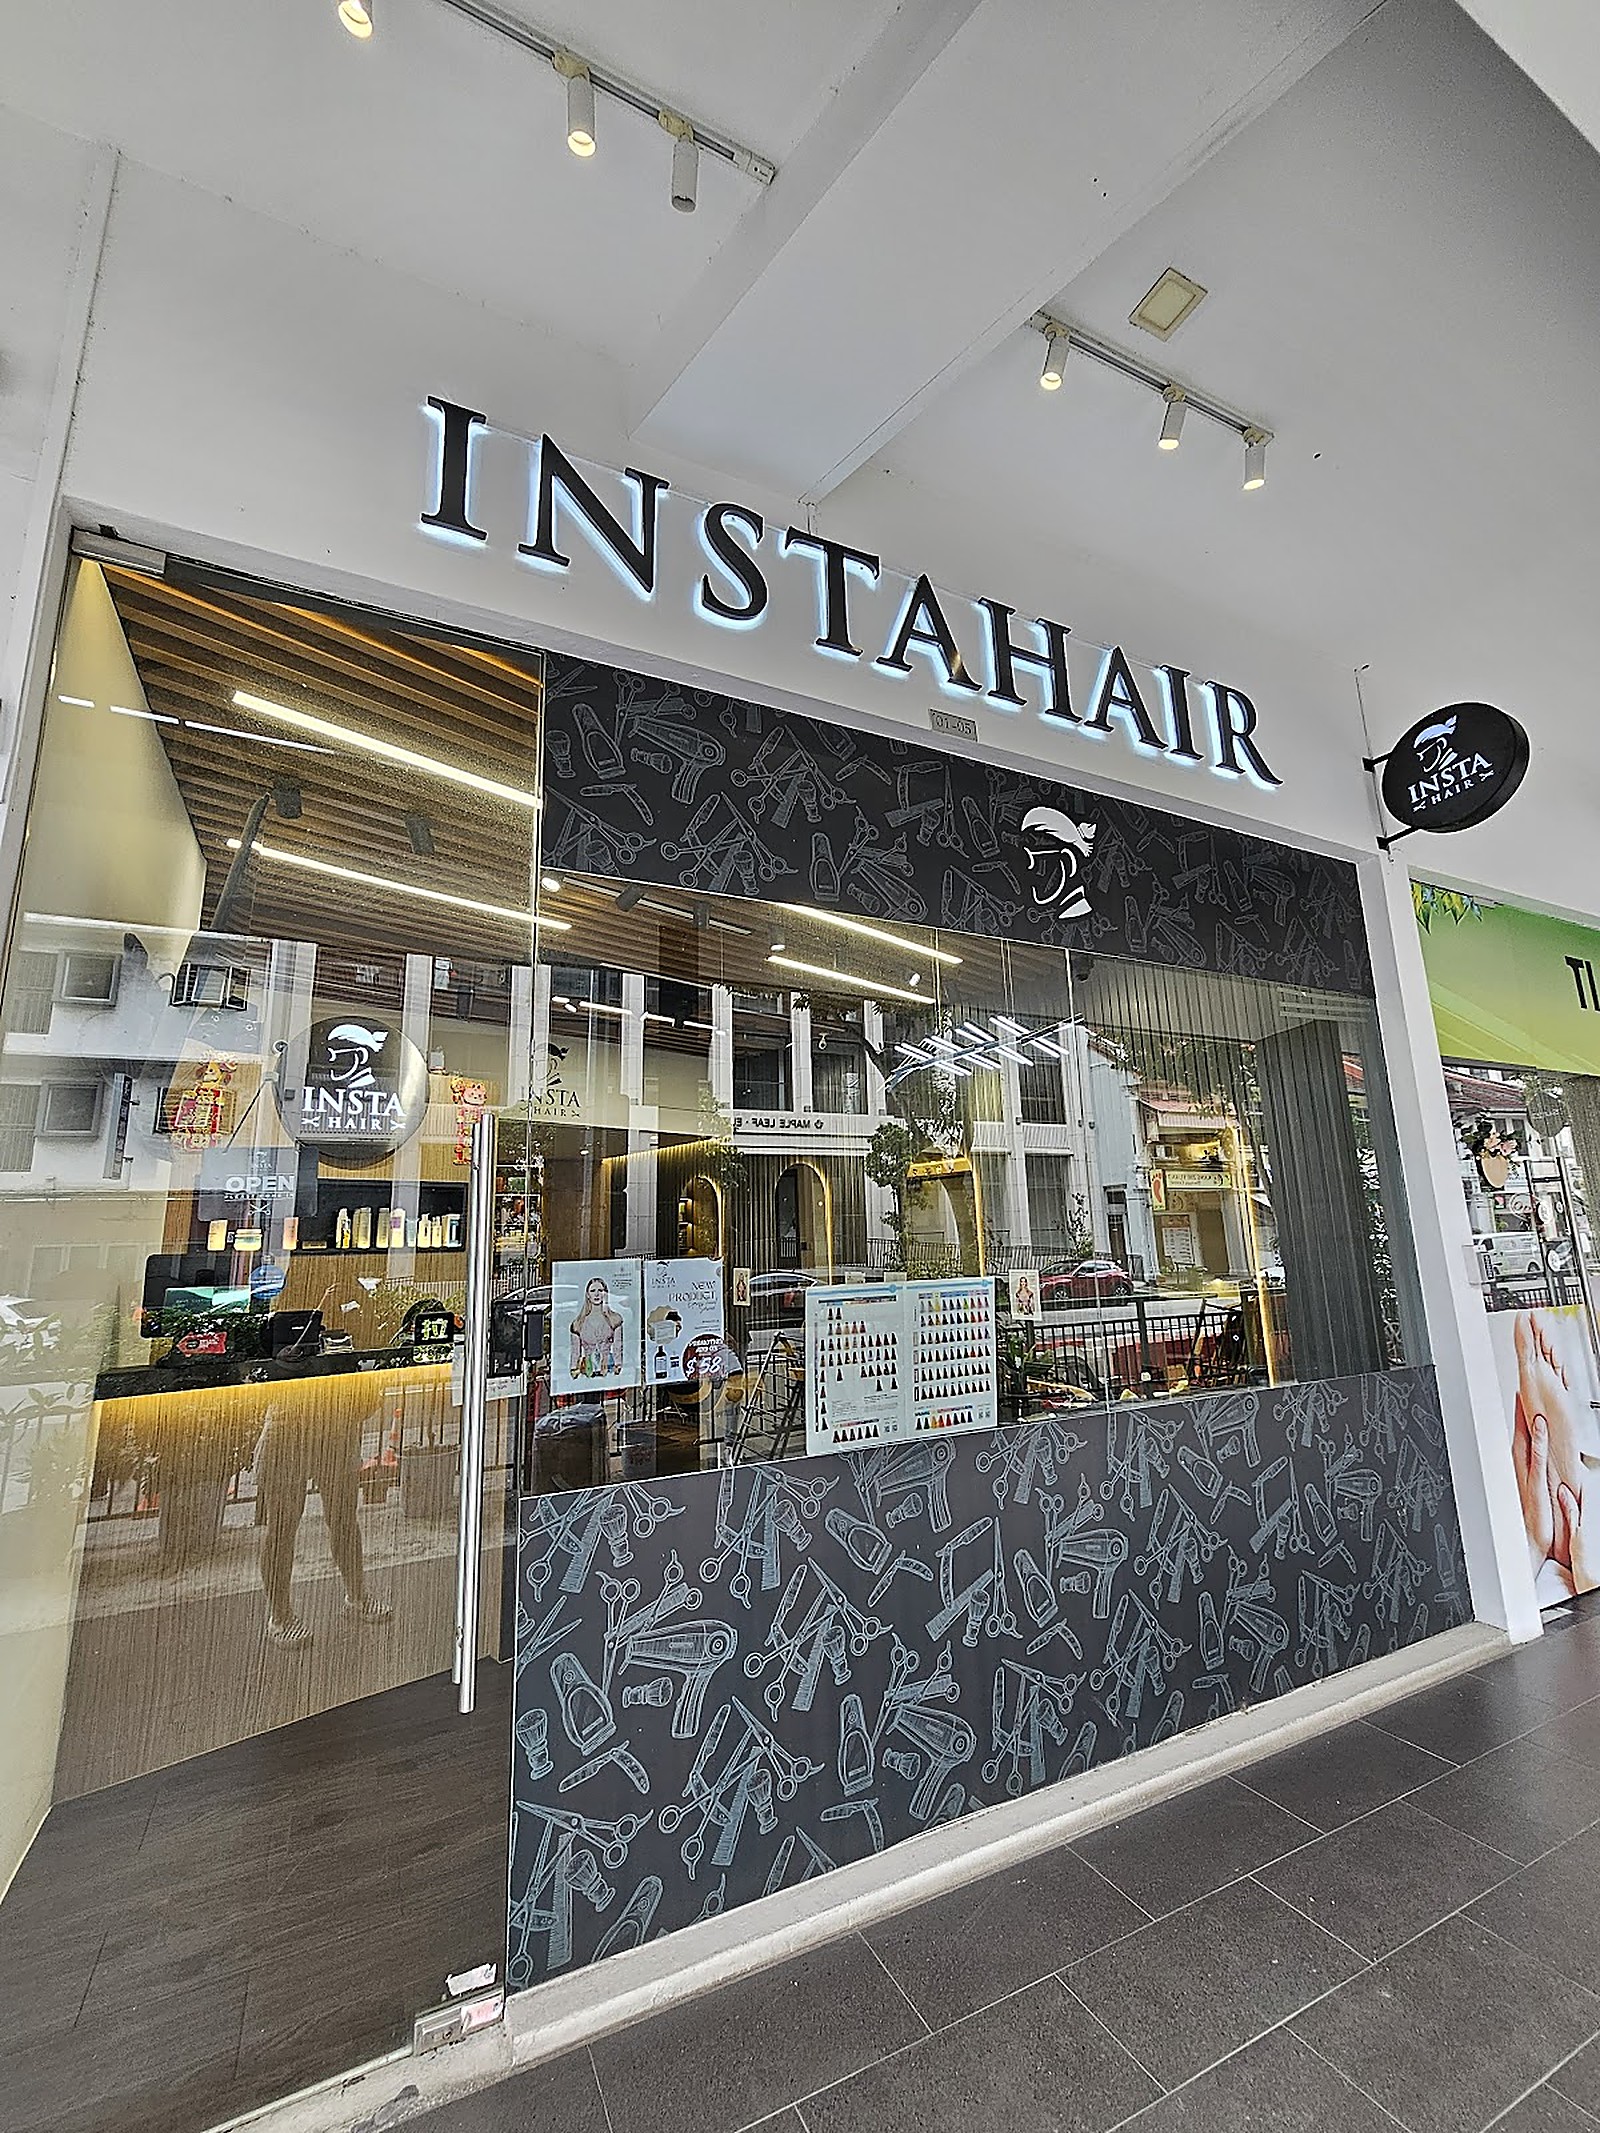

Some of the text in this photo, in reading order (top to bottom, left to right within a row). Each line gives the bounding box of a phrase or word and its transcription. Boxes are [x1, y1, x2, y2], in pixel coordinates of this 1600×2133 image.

[421, 396, 1284, 787] INSTAHAIR
[935, 714, 972, 735] 01-05
[1407, 752, 1493, 804] INSTA
[1431, 778, 1475, 805] HAIR
[301, 1086, 406, 1117] INSTA
[534, 1106, 567, 1117] HAIR
[328, 1116, 383, 1131] HAIR
[225, 1175, 295, 1193] OPEN
[691, 1281, 716, 1291] NEW
